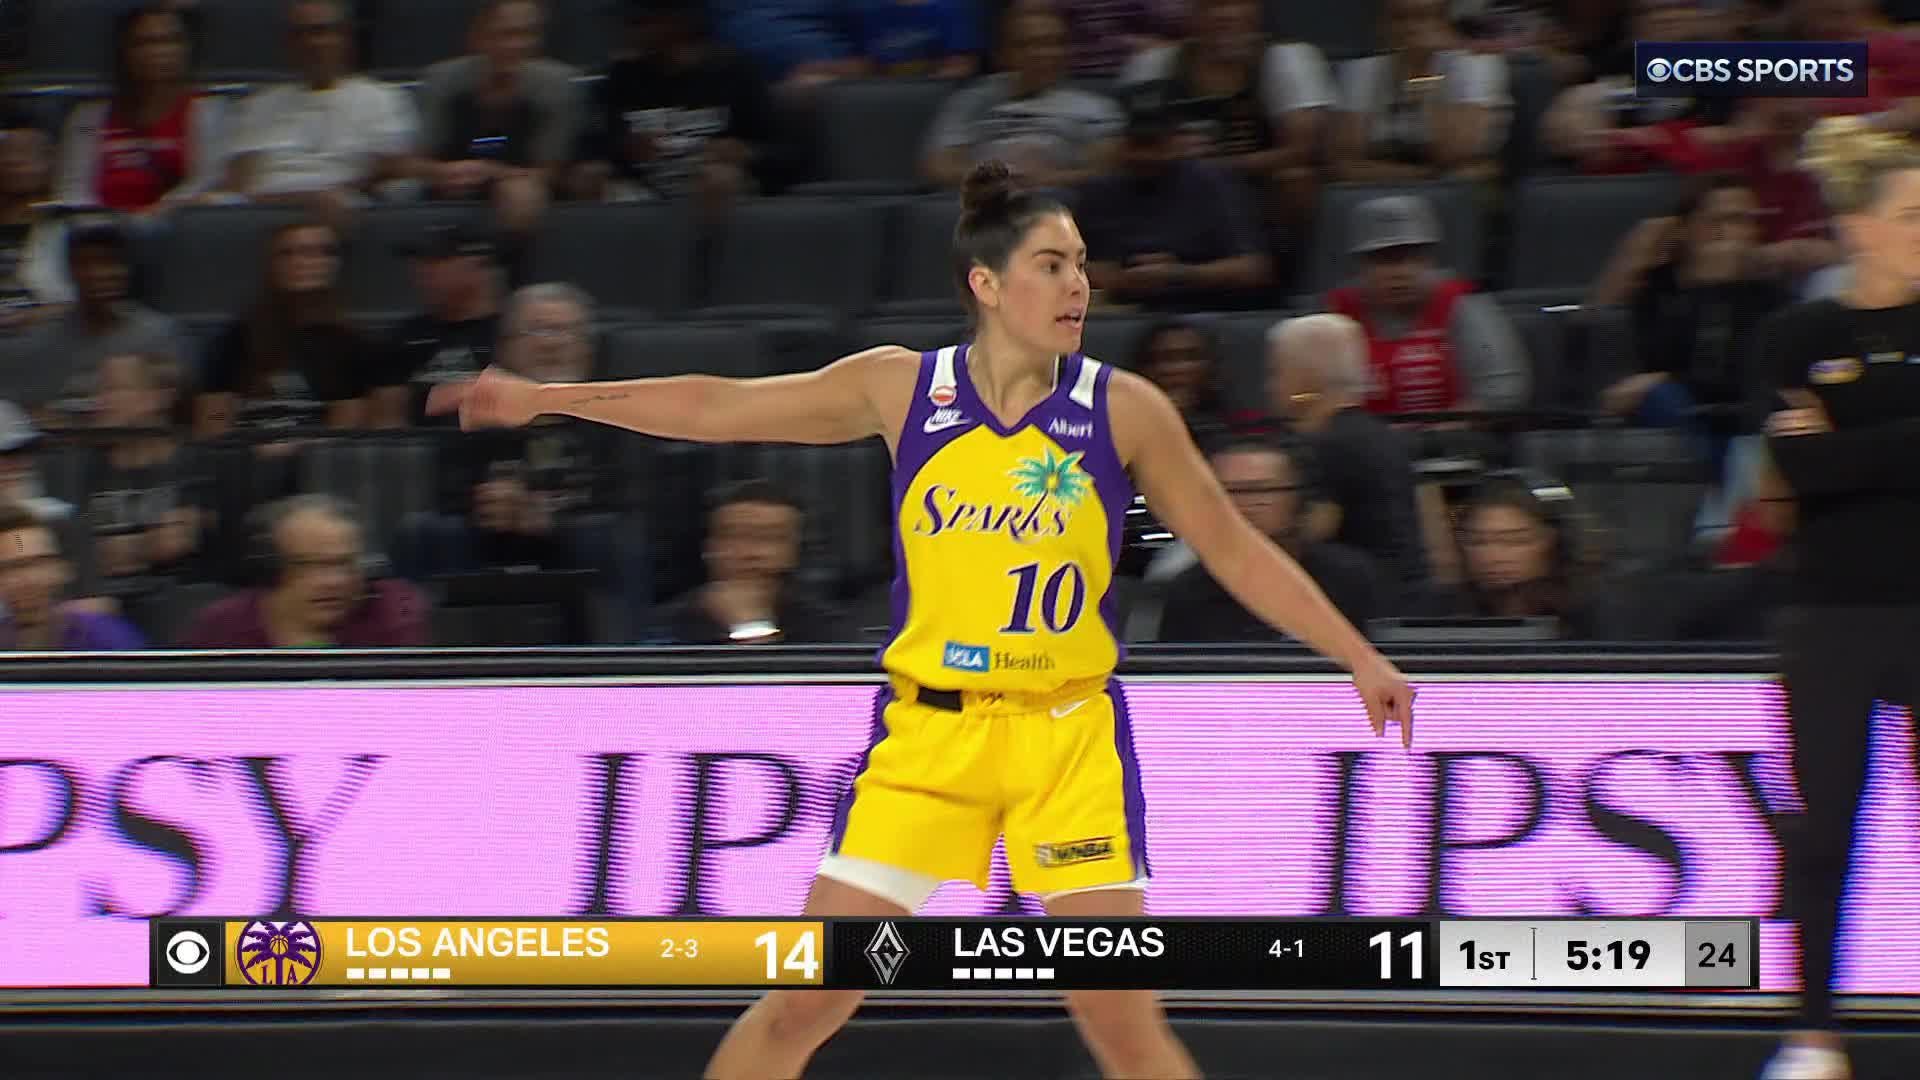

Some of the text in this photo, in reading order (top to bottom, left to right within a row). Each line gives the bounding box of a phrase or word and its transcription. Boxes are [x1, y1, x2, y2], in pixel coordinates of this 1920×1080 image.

[1048, 416, 1093, 439] Albert
[999, 561, 1086, 634] 10
[993, 651, 1056, 671] Health
